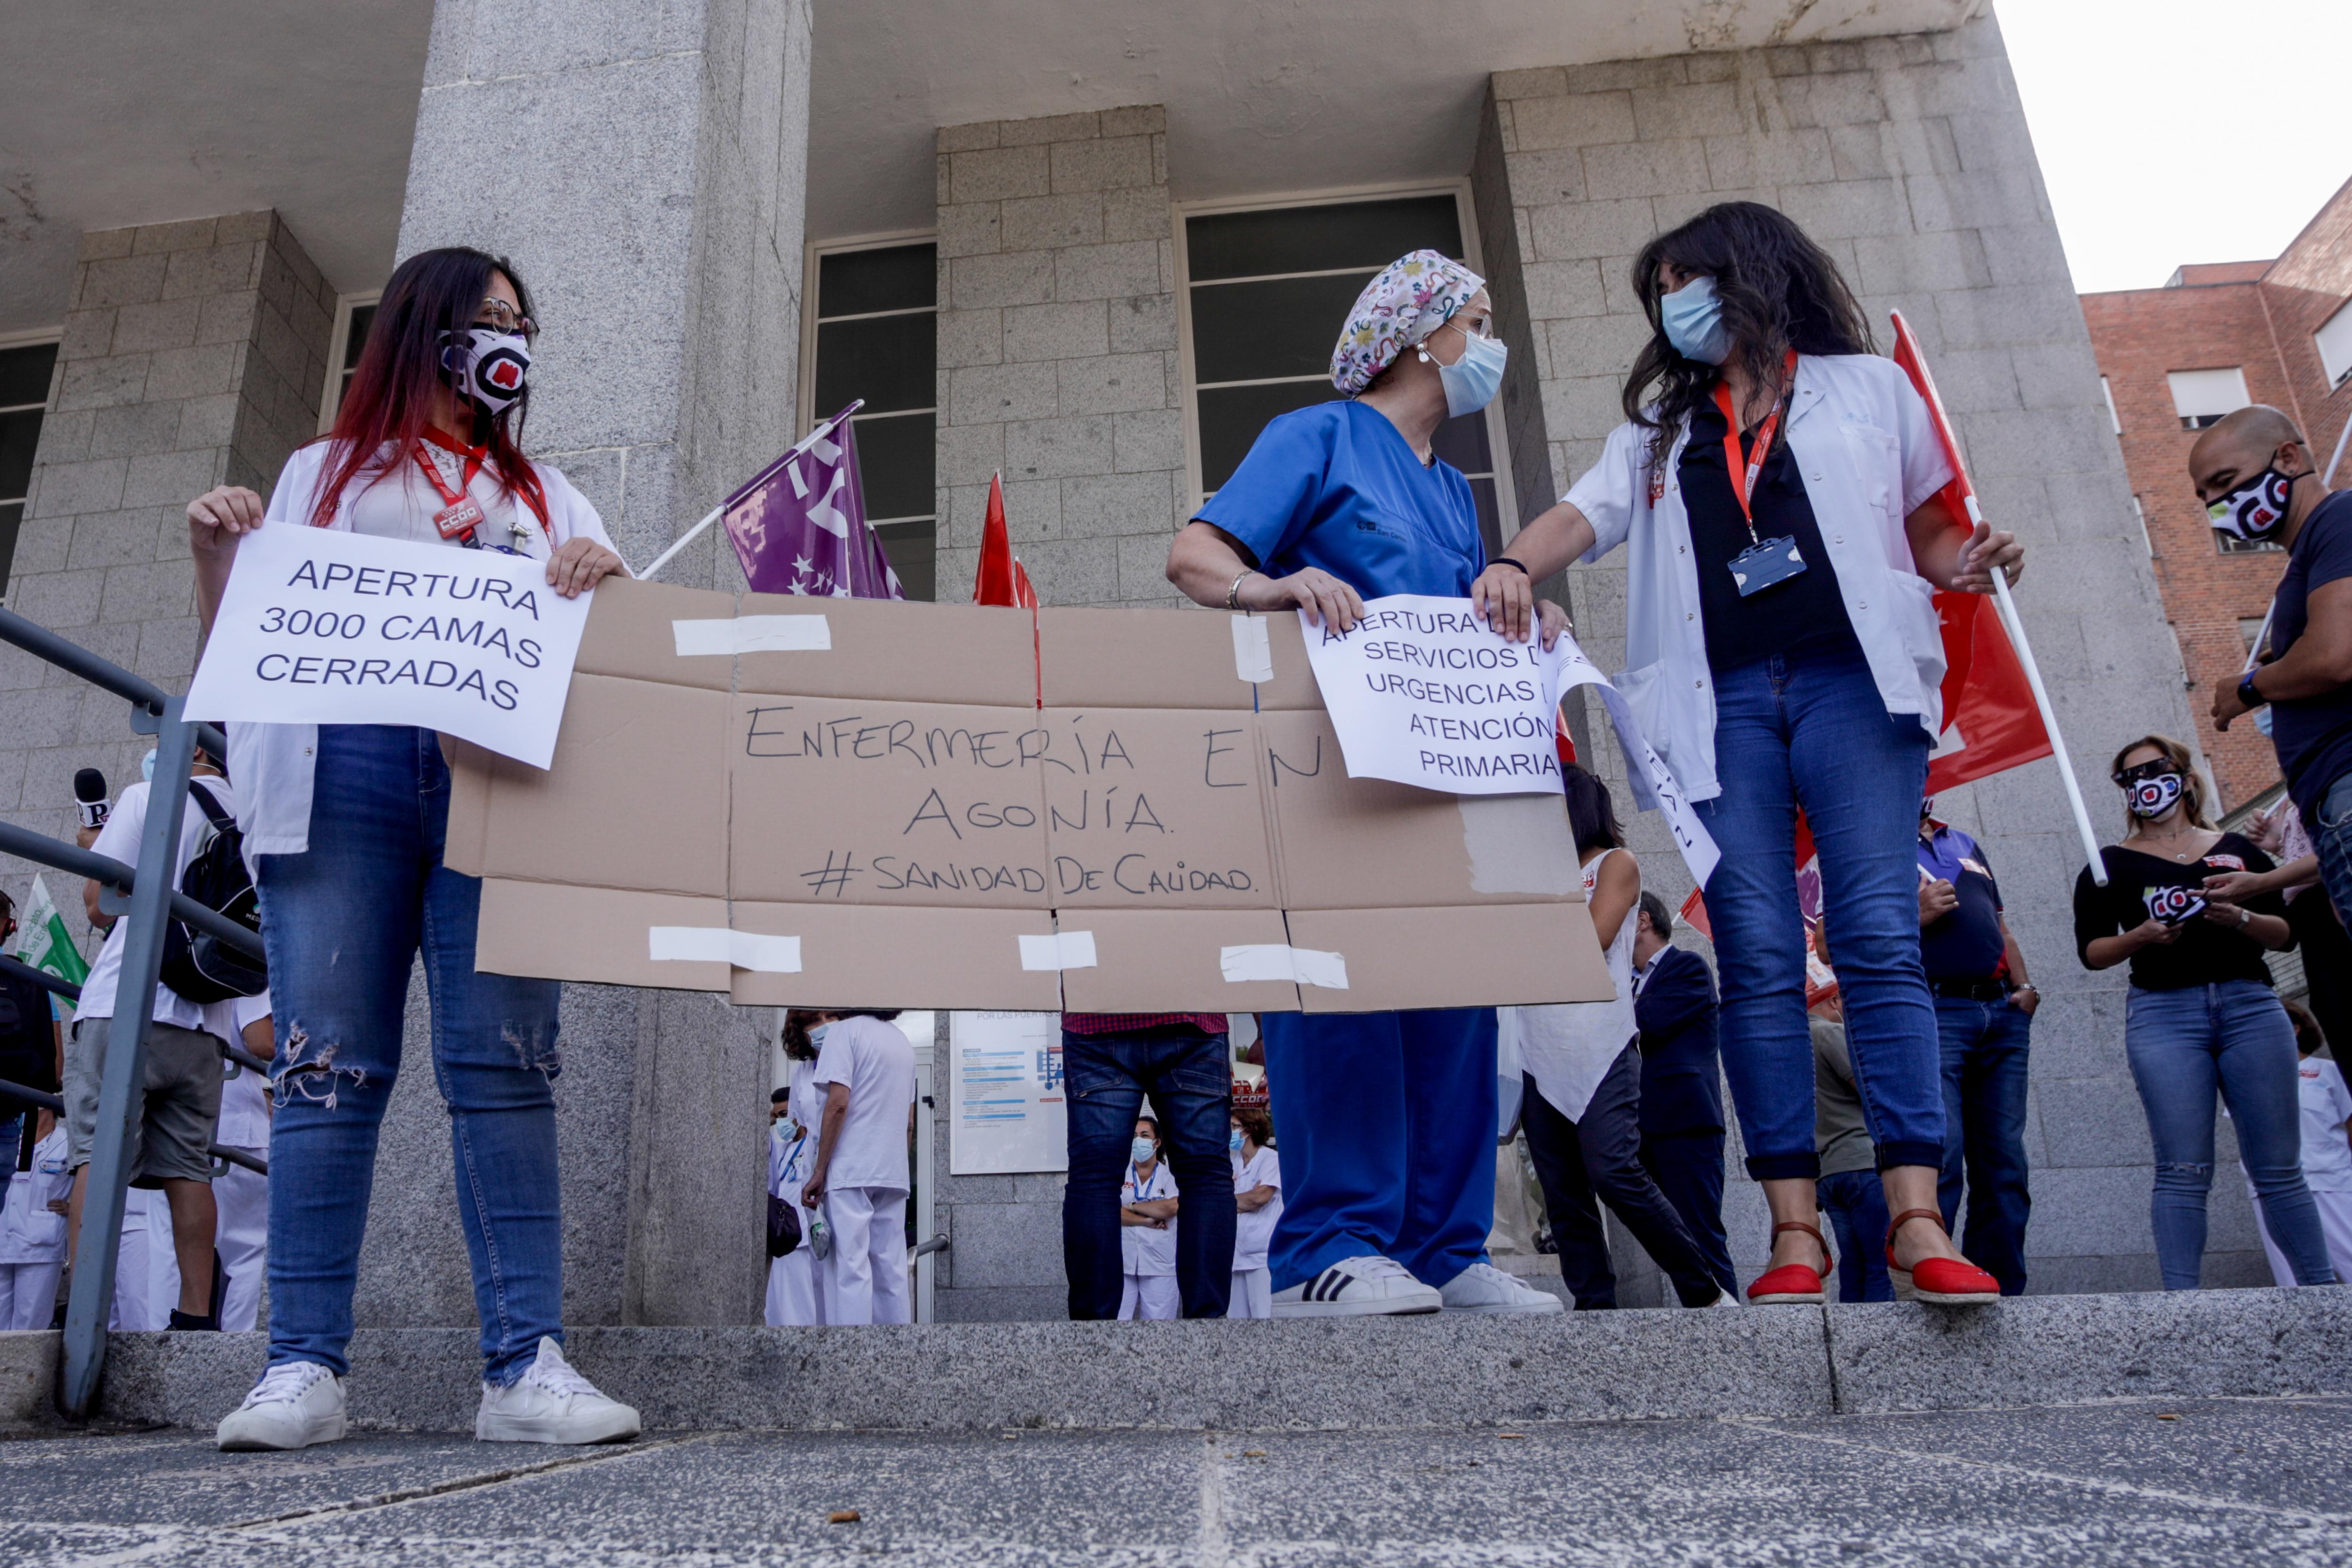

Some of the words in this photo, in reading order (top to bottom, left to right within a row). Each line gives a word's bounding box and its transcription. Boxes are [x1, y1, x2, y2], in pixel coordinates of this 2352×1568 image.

[439, 507, 477, 530] CCOO
[288, 559, 540, 621] APERTURA
[259, 607, 366, 639] 3000
[380, 615, 543, 669] CAMAS
[1364, 641, 1519, 668] SERVICIOS
[255, 653, 520, 711] CERRADAS
[1366, 673, 1535, 705] URGENCIAS
[1410, 711, 1554, 740] ATENCIÓN
[746, 706, 1134, 775] ENFERMERÍA
[1203, 729, 1320, 787] EN
[1420, 750, 1559, 777] PRIMARIA
[87, 804, 108, 825] P
[246, 913, 261, 923] MED
